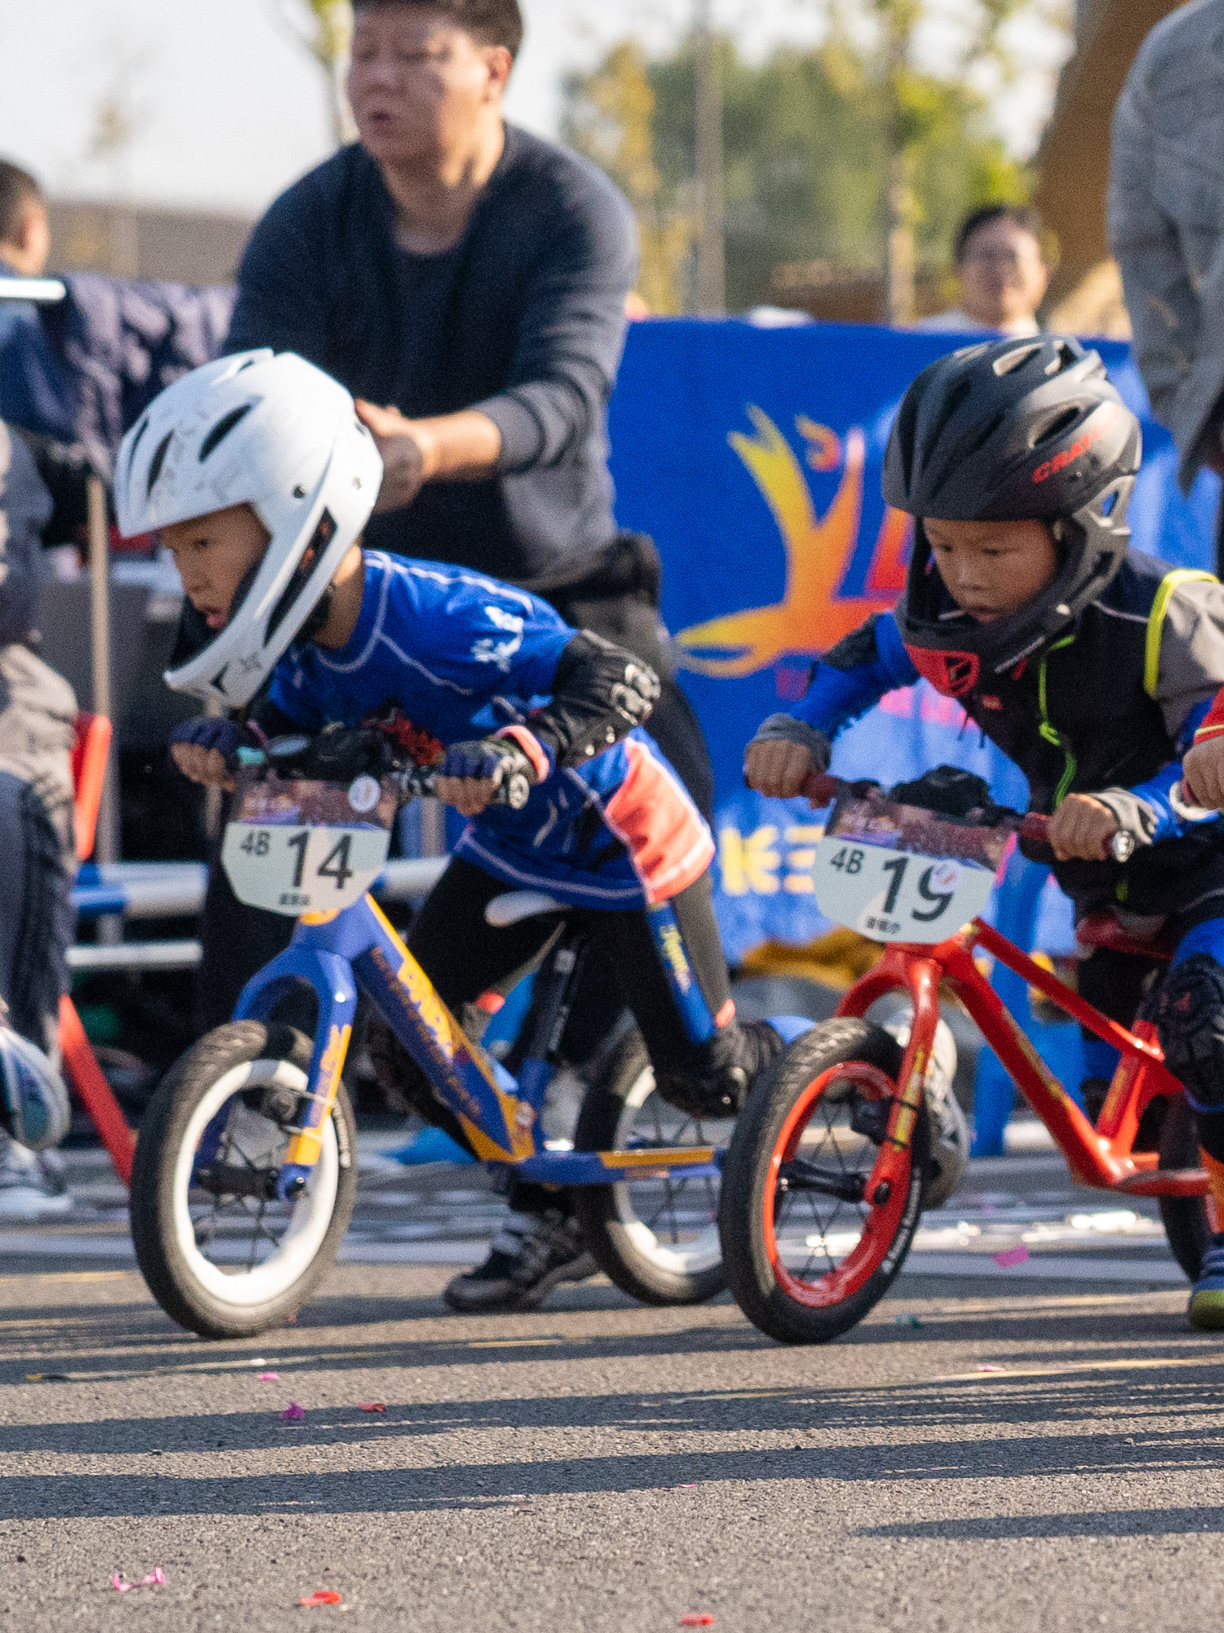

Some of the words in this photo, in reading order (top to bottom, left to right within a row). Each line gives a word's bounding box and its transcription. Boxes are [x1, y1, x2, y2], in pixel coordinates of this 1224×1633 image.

[240, 830, 270, 856] 4B
[288, 831, 353, 890] 14
[830, 847, 865, 875] 4B
[882, 857, 954, 923] 19
